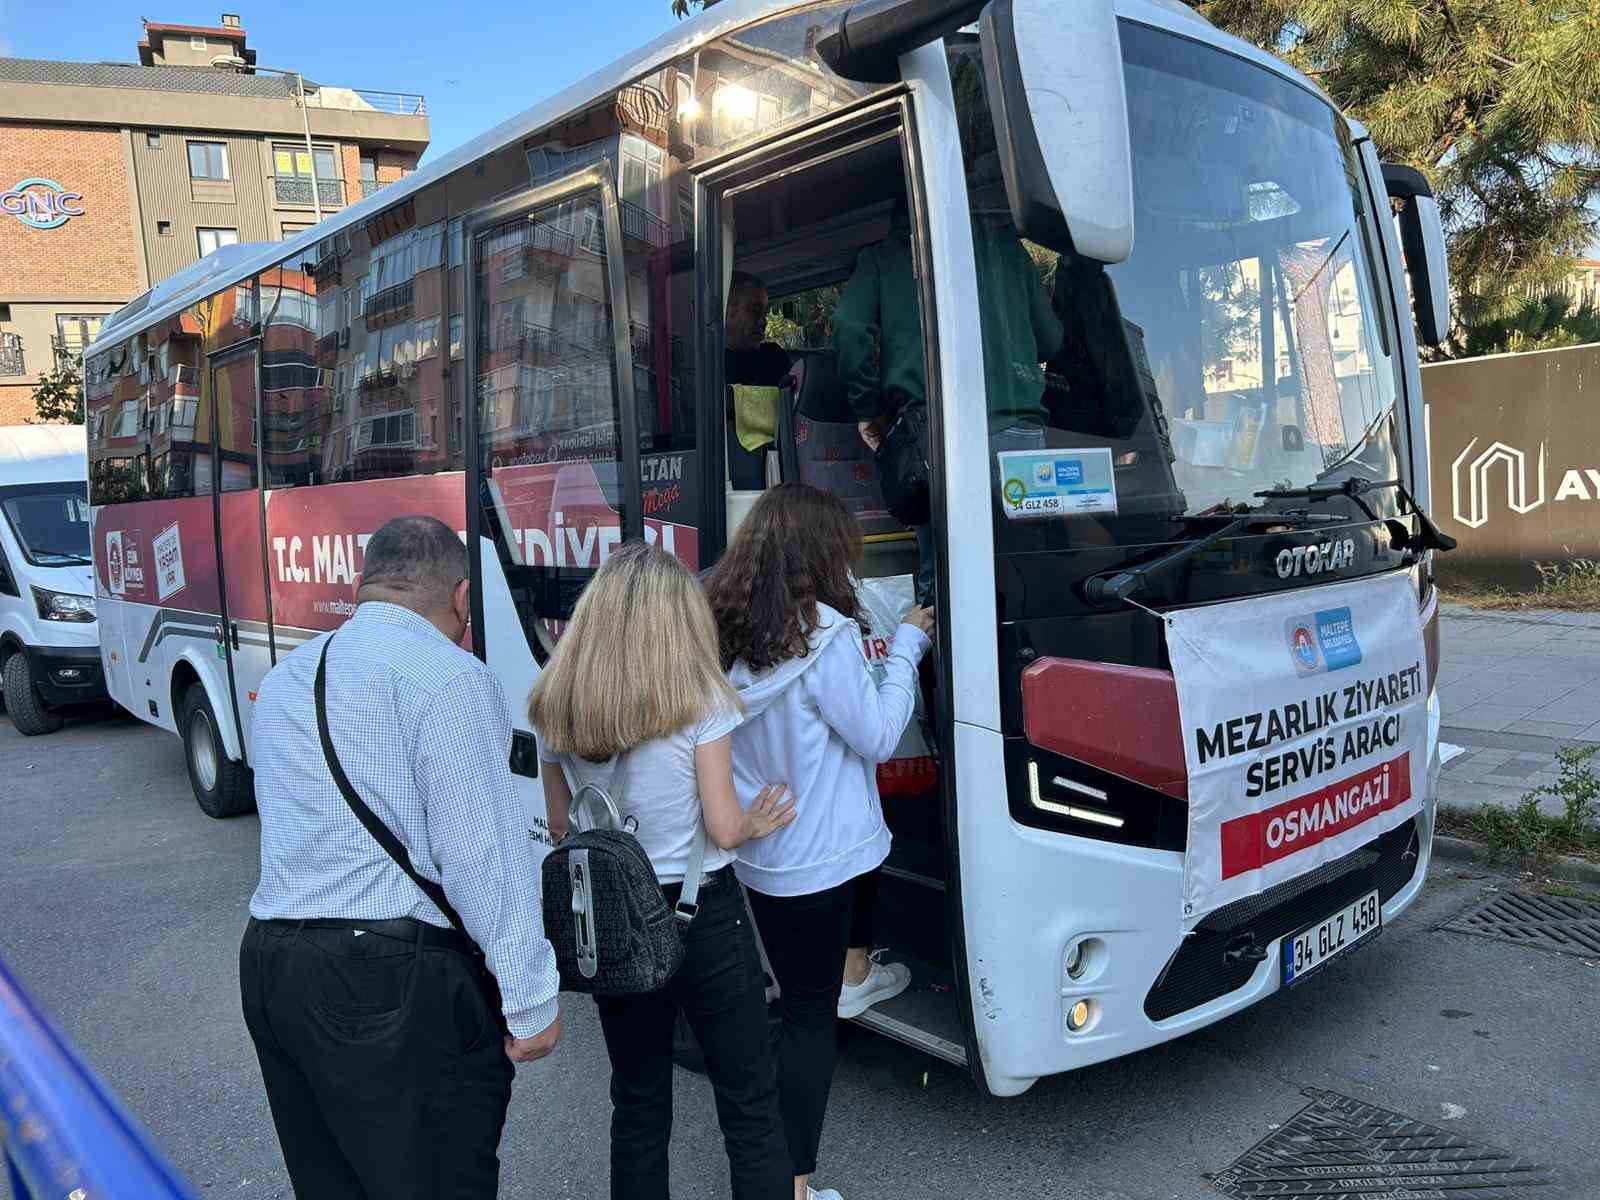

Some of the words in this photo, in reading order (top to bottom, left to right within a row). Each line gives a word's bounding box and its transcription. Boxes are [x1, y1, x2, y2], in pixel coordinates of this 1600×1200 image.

[0, 190, 84, 217] GNC
[640, 456, 683, 481] LTAN
[1025, 500, 1041, 510] GLZ
[1043, 498, 1059, 508] 458
[273, 535, 311, 583] T.C.
[312, 534, 373, 585] MALT
[1276, 538, 1355, 579] OTOKAR
[312, 599, 357, 617] www.maltep
[1195, 691, 1339, 764] MEZARLIK
[1343, 661, 1421, 720] ZİYARETİ
[1245, 736, 1336, 798] SERVİS
[1340, 713, 1401, 765] ARACI
[533, 815, 549, 830] MAL
[1266, 763, 1390, 849] OSMANGAZİ
[1294, 935, 1313, 972] 34
[1319, 912, 1345, 957] GLZ
[1352, 894, 1376, 935] 458
